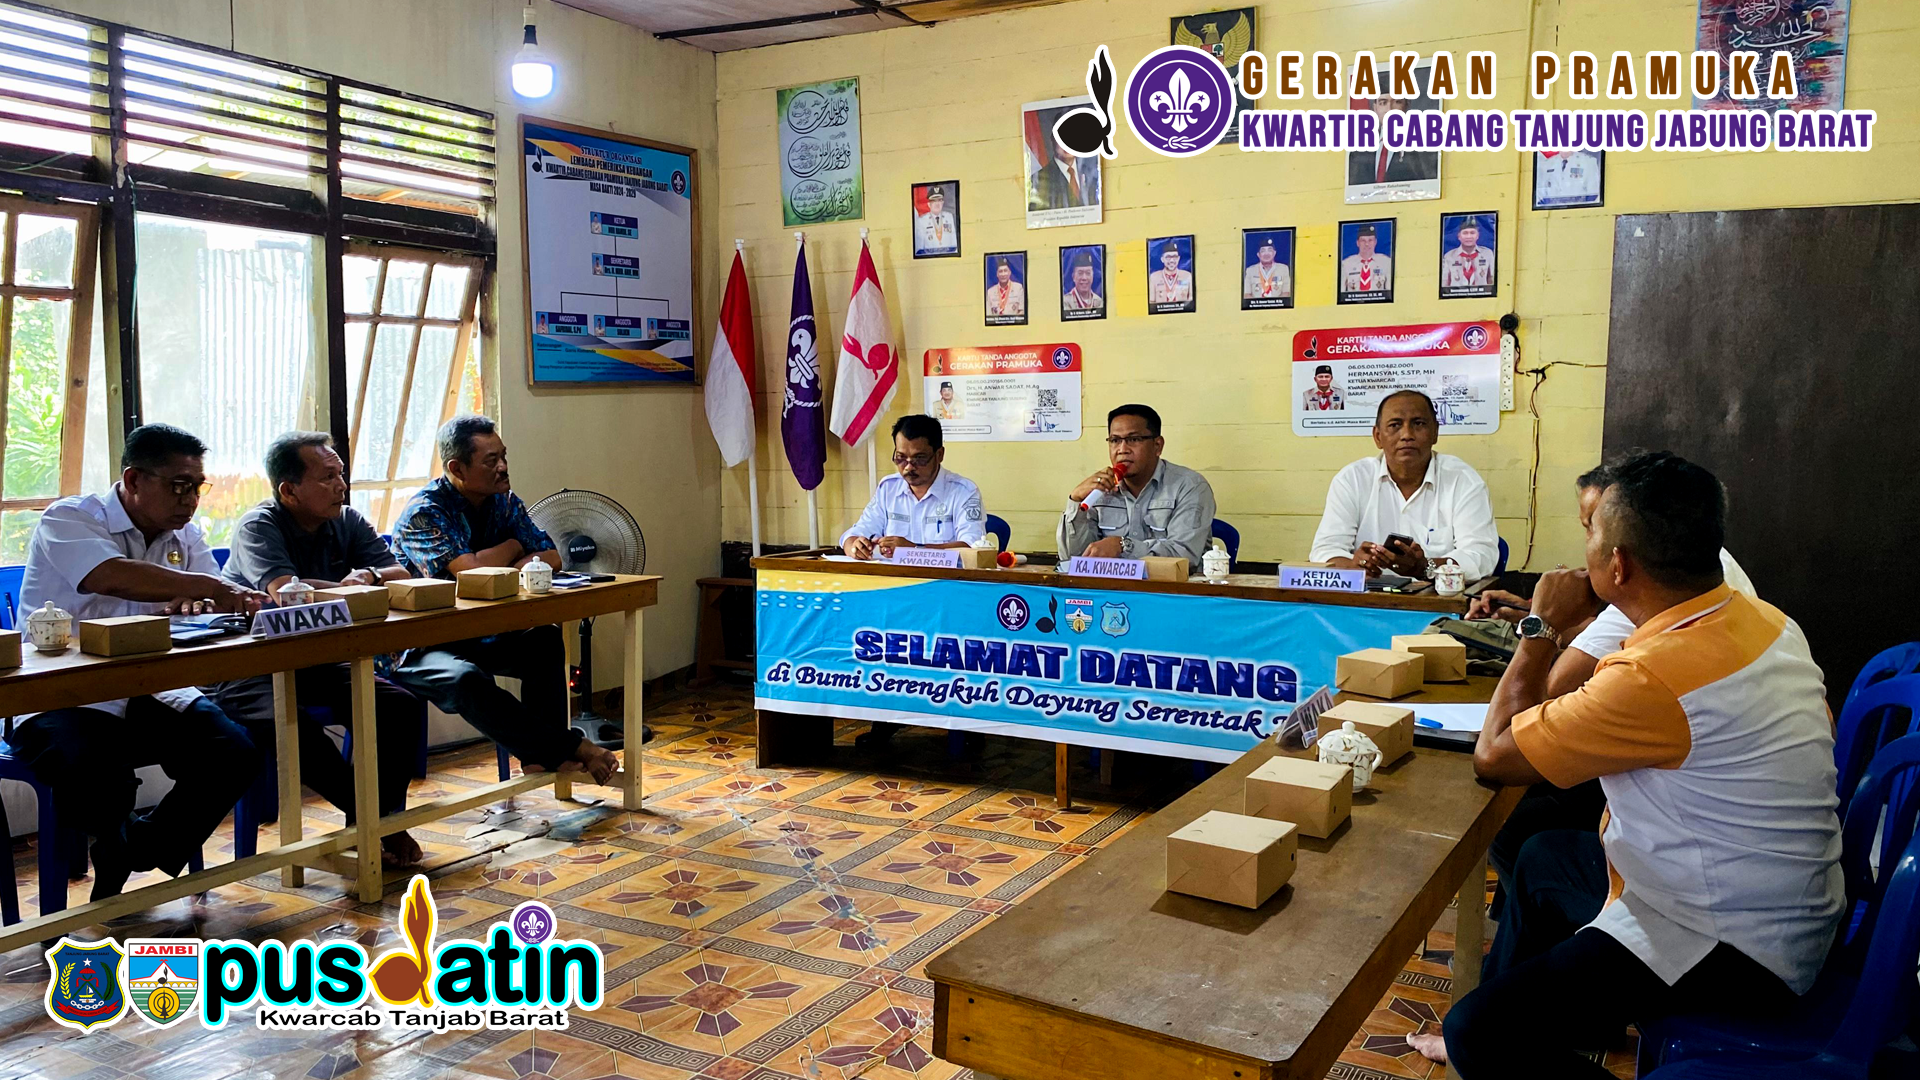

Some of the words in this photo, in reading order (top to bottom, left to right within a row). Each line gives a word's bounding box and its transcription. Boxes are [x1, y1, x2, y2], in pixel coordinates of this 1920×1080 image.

[581, 145, 610, 160] STRUKTUR
[611, 152, 643, 165] ORGANISASI
[570, 155, 596, 169] LEMBAGA
[596, 159, 626, 173] PEMERIKSA
[627, 165, 653, 178] KEUANGAN
[590, 181, 601, 193] MASA
[602, 184, 613, 195] BAKTI
[559, 315, 577, 323] ANGGOTA
[1337, 335, 1366, 344] KARTU
[1367, 334, 1397, 343] TANDA
[1003, 352, 1037, 360] ANGGOTA
[950, 361, 993, 370] GERAKAN
[996, 360, 1043, 369] PRAMUKA
[906, 550, 946, 559] SEKRETARIS
[899, 557, 952, 567] KWARCAB
[1075, 560, 1090, 573] KA.
[1092, 561, 1137, 576] KWARCAB
[1303, 570, 1341, 580] KETUA
[1290, 578, 1352, 588] HARIAN
[266, 604, 348, 634] WAKA
[854, 630, 1068, 680] SELAMAT
[1080, 649, 1297, 703] DATANG
[767, 662, 791, 683] di
[796, 665, 862, 689] Bumi
[866, 672, 999, 705] Serengkuh
[1006, 686, 1120, 723] Dayung
[1125, 700, 1270, 739] Serentak
